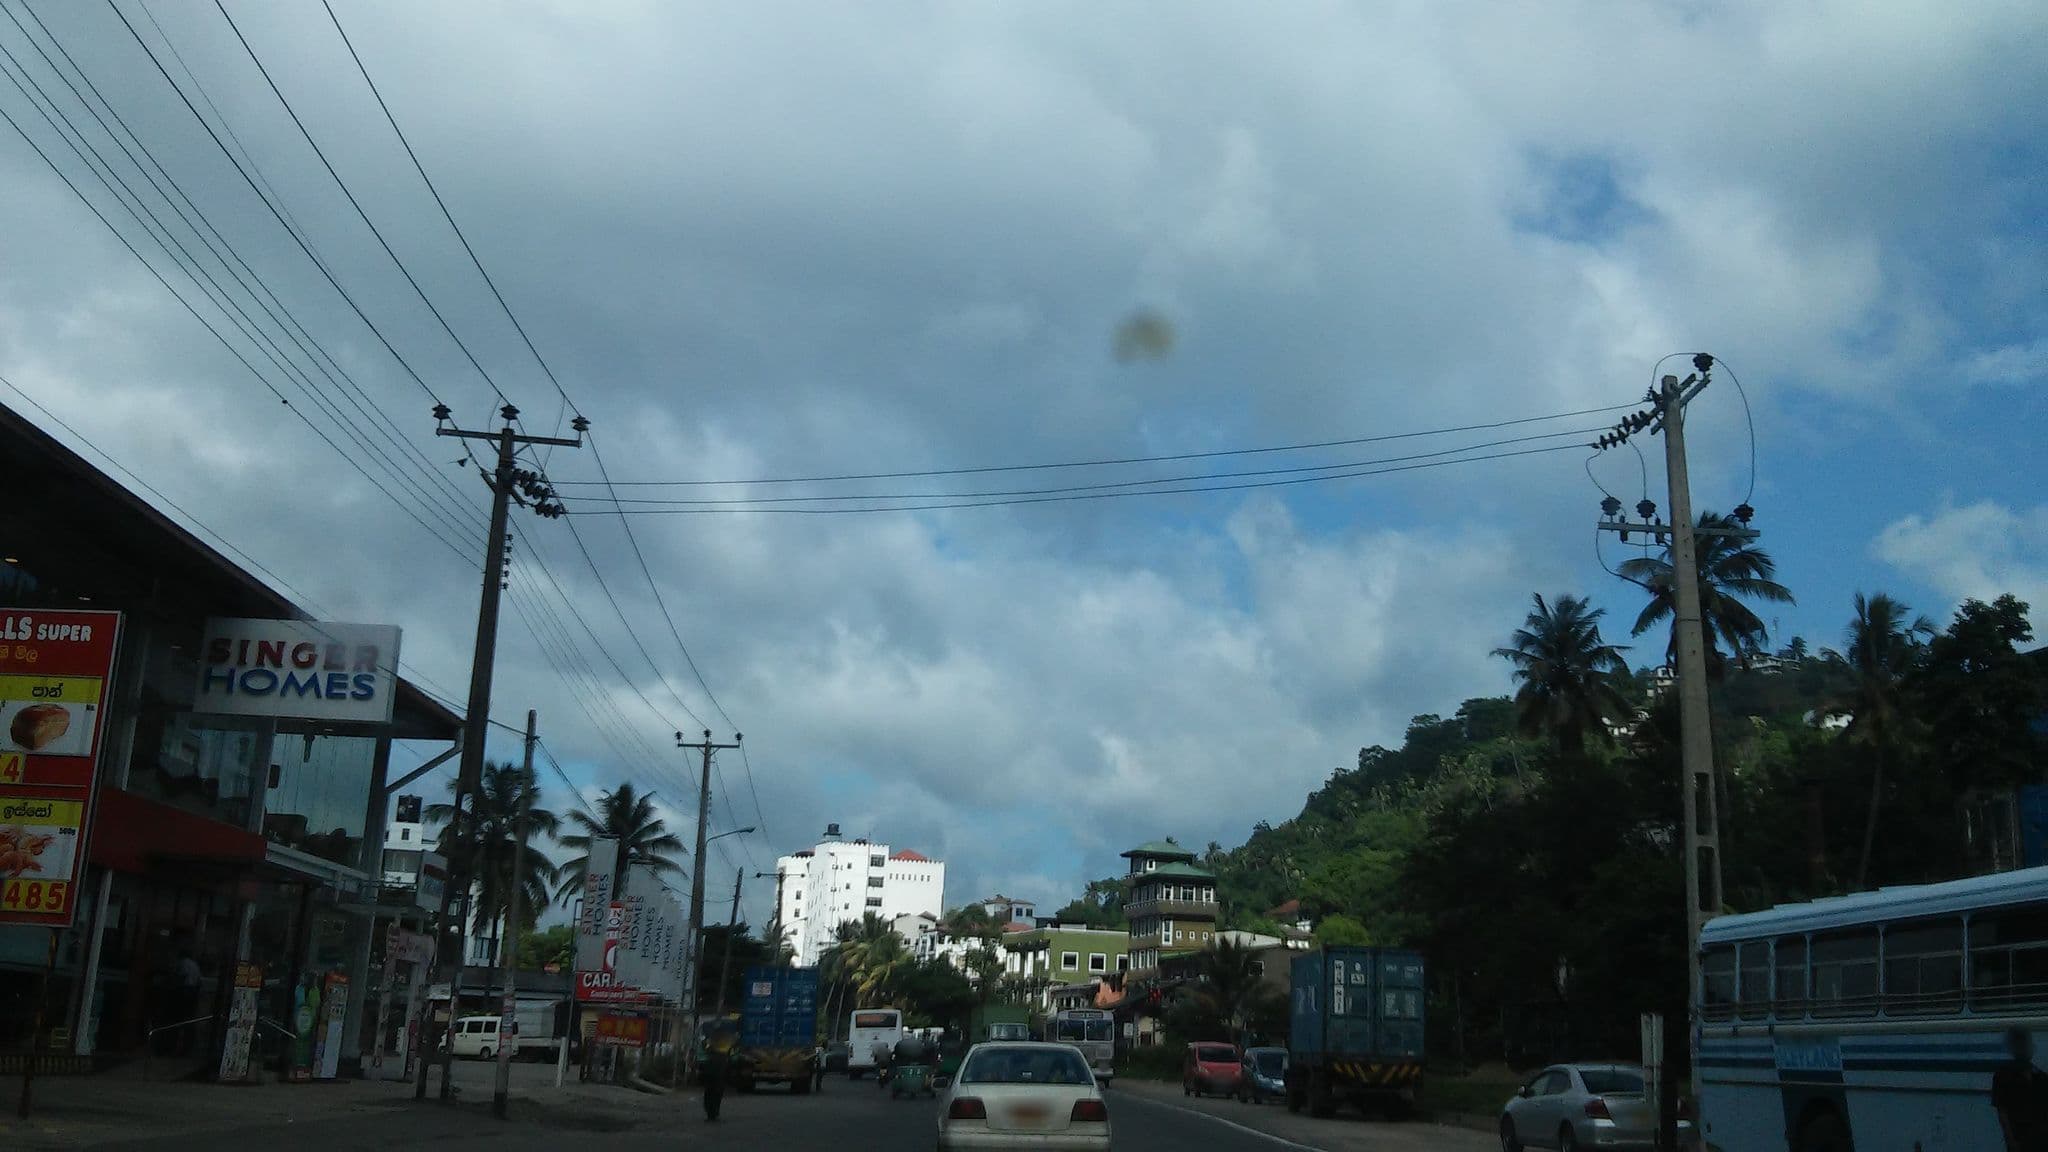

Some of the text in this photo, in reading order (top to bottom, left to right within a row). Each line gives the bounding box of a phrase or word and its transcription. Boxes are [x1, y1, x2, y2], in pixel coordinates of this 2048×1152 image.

[37, 624, 92, 641] SUPER
[207, 637, 379, 672] SINGER
[203, 667, 376, 700] HOMES
[4, 882, 64, 910] 485
[583, 873, 600, 936] SINGER
[592, 873, 609, 936] HOMES
[620, 895, 637, 950] SINGER
[629, 895, 644, 951] HOMES
[641, 907, 655, 958] HOMES
[651, 916, 664, 965] HOMES
